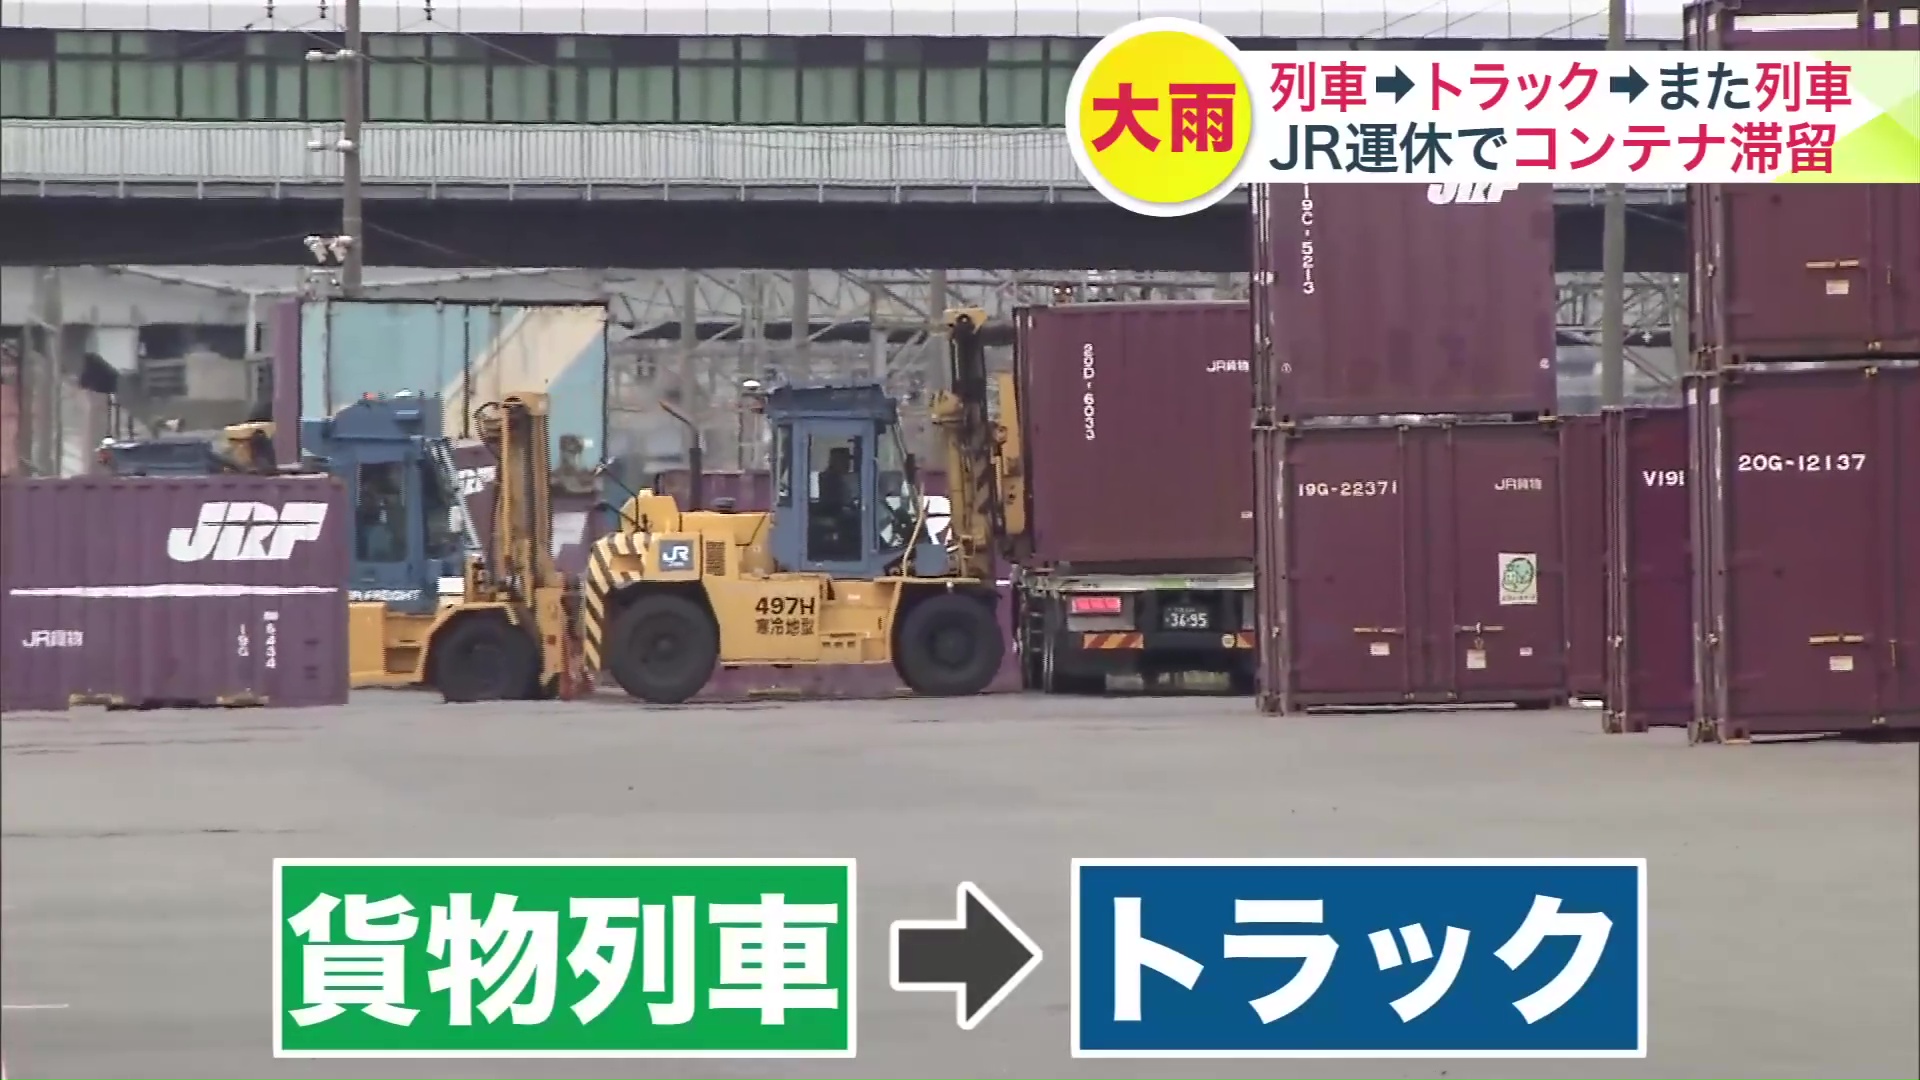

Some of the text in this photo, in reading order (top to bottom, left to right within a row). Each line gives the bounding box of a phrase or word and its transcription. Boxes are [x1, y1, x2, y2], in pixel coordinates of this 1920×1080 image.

[1738, 453, 1866, 472] 20G-12137
[1297, 481, 1398, 497] 19G-22371
[167, 502, 328, 562] JRF
[662, 545, 689, 561] JR
[755, 596, 816, 616] 497H
